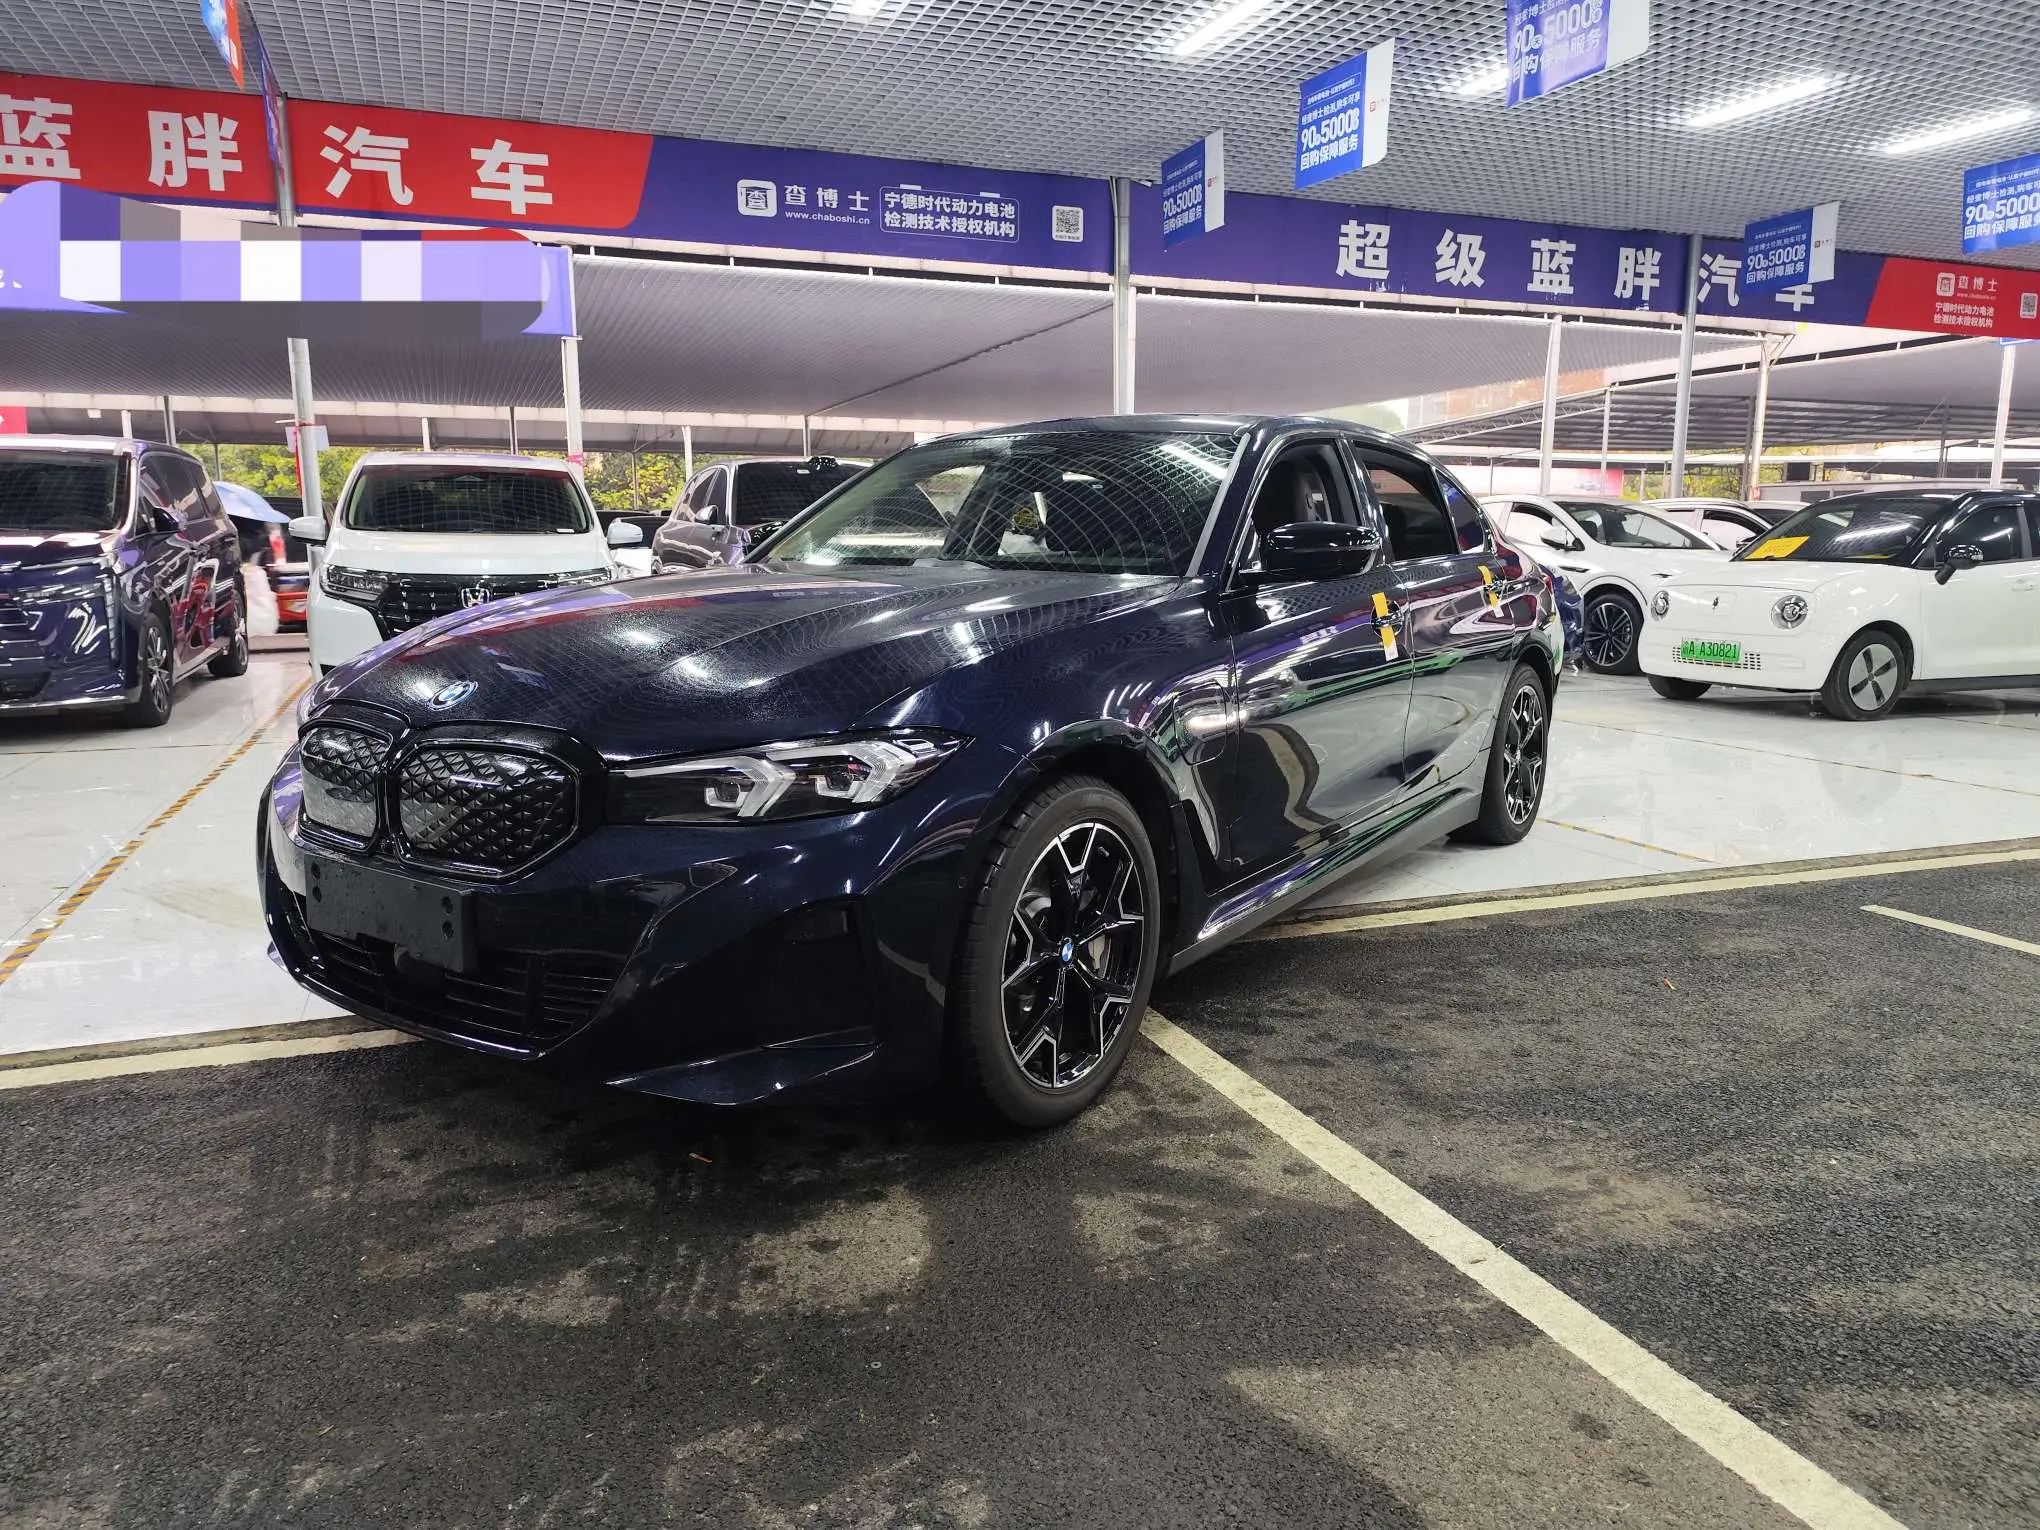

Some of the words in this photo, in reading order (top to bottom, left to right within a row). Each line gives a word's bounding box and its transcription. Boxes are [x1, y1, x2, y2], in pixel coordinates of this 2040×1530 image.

[784, 184, 870, 212] 查博士
[884, 191, 1016, 219] 宁德时代动力电池
[784, 210, 871, 225] www.chaboshi.cn
[884, 211, 1015, 238] 检测技术授权机构
[1746, 262, 1805, 284] 回购保障服务
